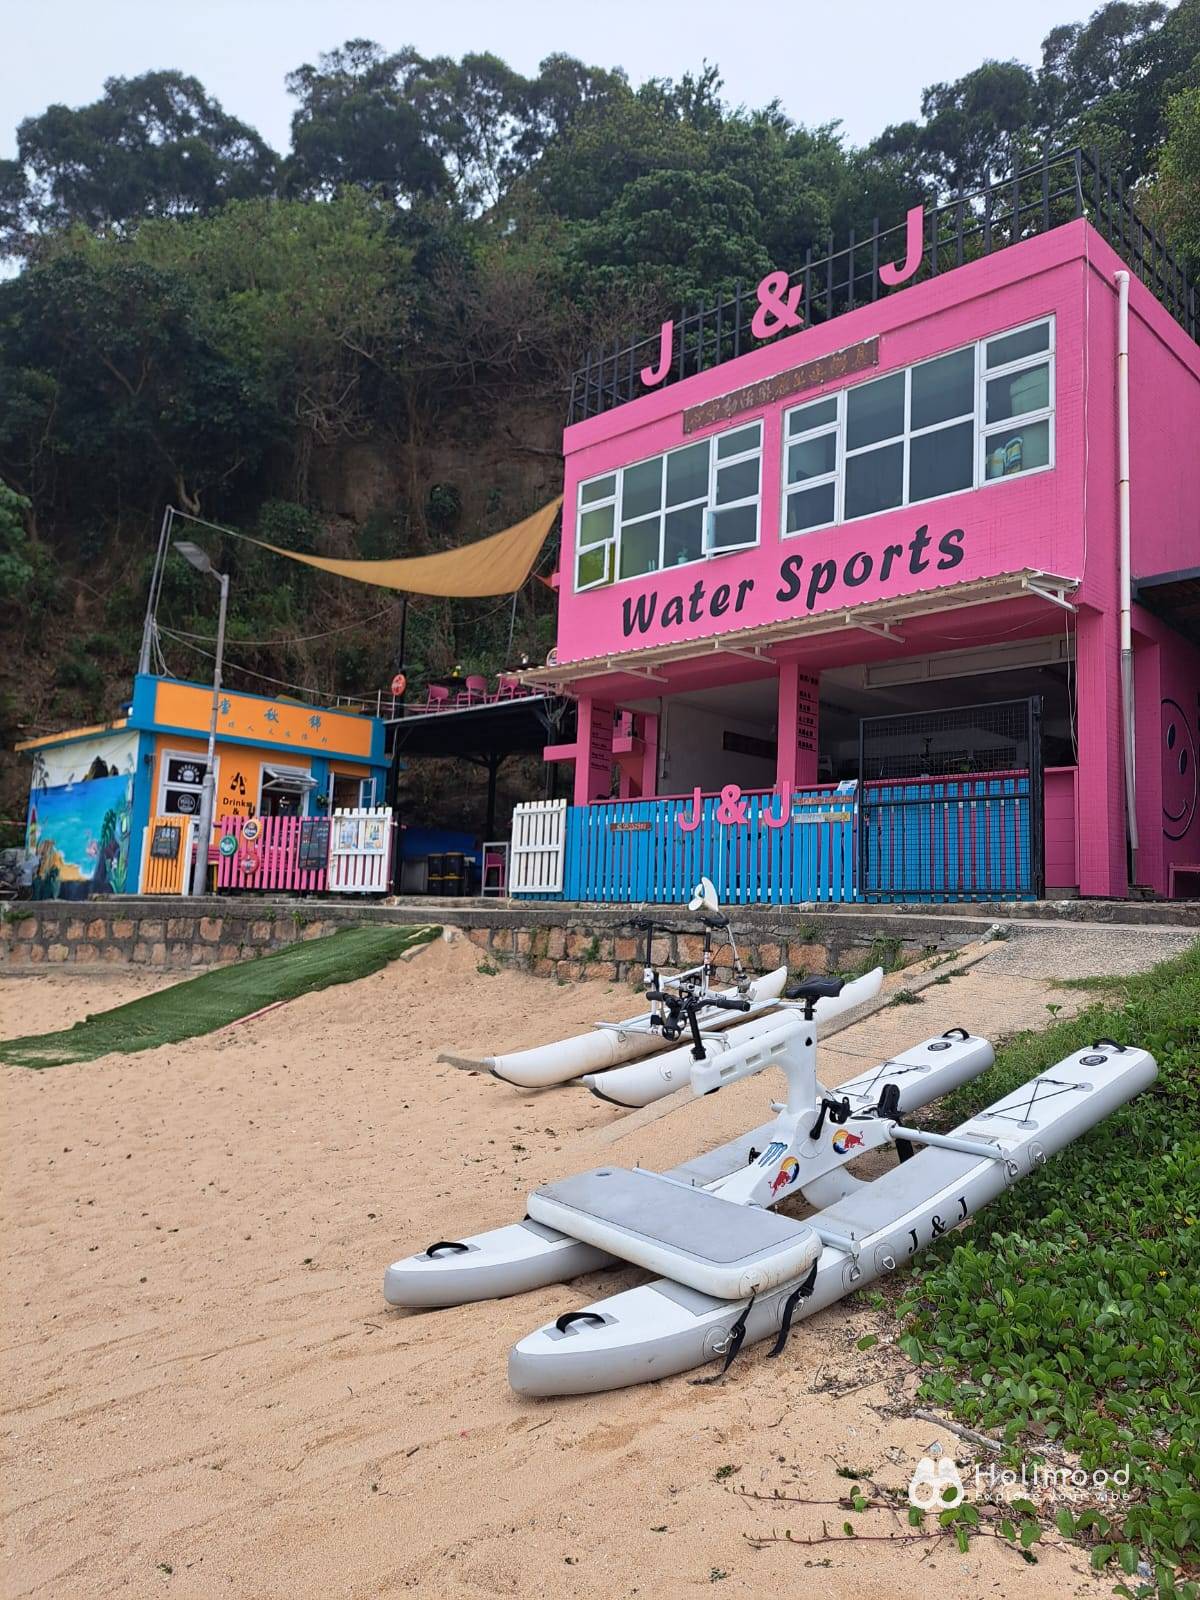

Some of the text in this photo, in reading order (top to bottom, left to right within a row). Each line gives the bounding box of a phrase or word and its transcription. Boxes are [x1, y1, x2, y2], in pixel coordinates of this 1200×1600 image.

[641, 320, 673, 386] J
[751, 271, 804, 339] &
[879, 204, 924, 286] J
[622, 524, 965, 637] Water Sports
[678, 781, 790, 831] J & J
[908, 1196, 968, 1255] J & J
